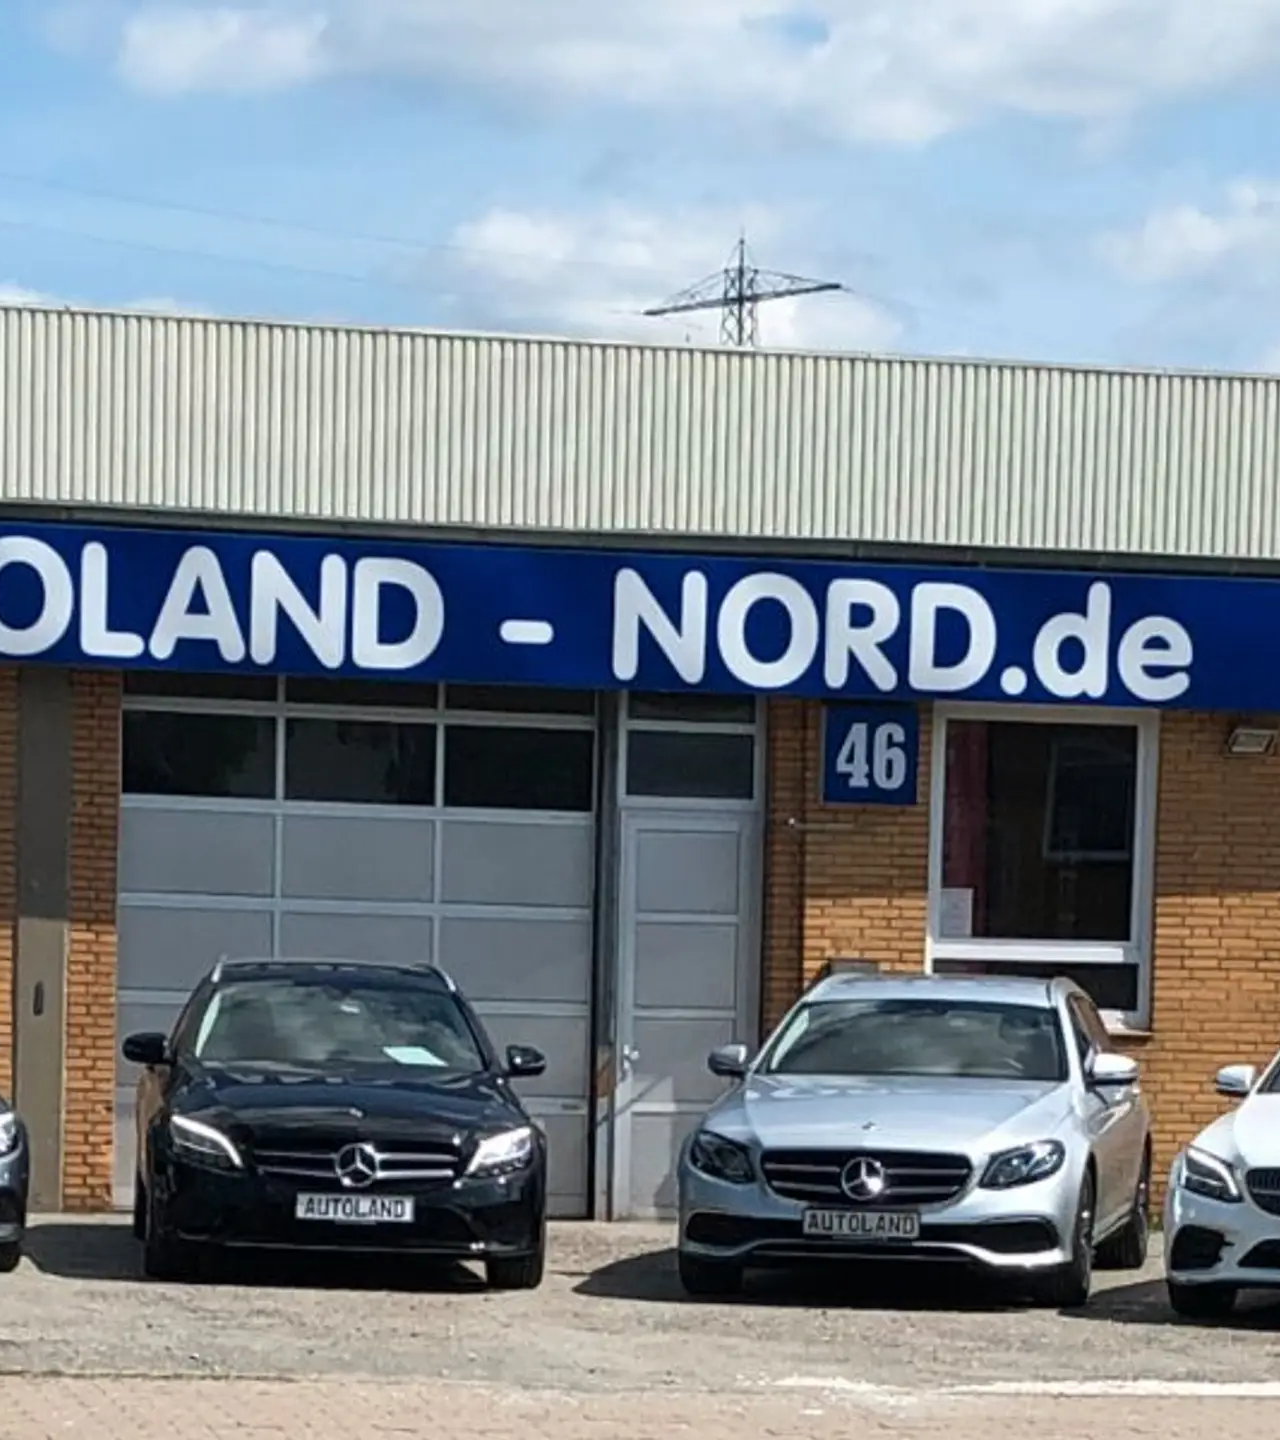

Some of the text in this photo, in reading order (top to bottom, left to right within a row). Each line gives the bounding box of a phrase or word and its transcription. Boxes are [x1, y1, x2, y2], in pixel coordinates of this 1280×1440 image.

[612, 568, 1193, 701] NORD.de
[836, 722, 906, 790] 46
[304, 1195, 406, 1218] AUTOLAND
[807, 1211, 915, 1234] AUTOLAND
